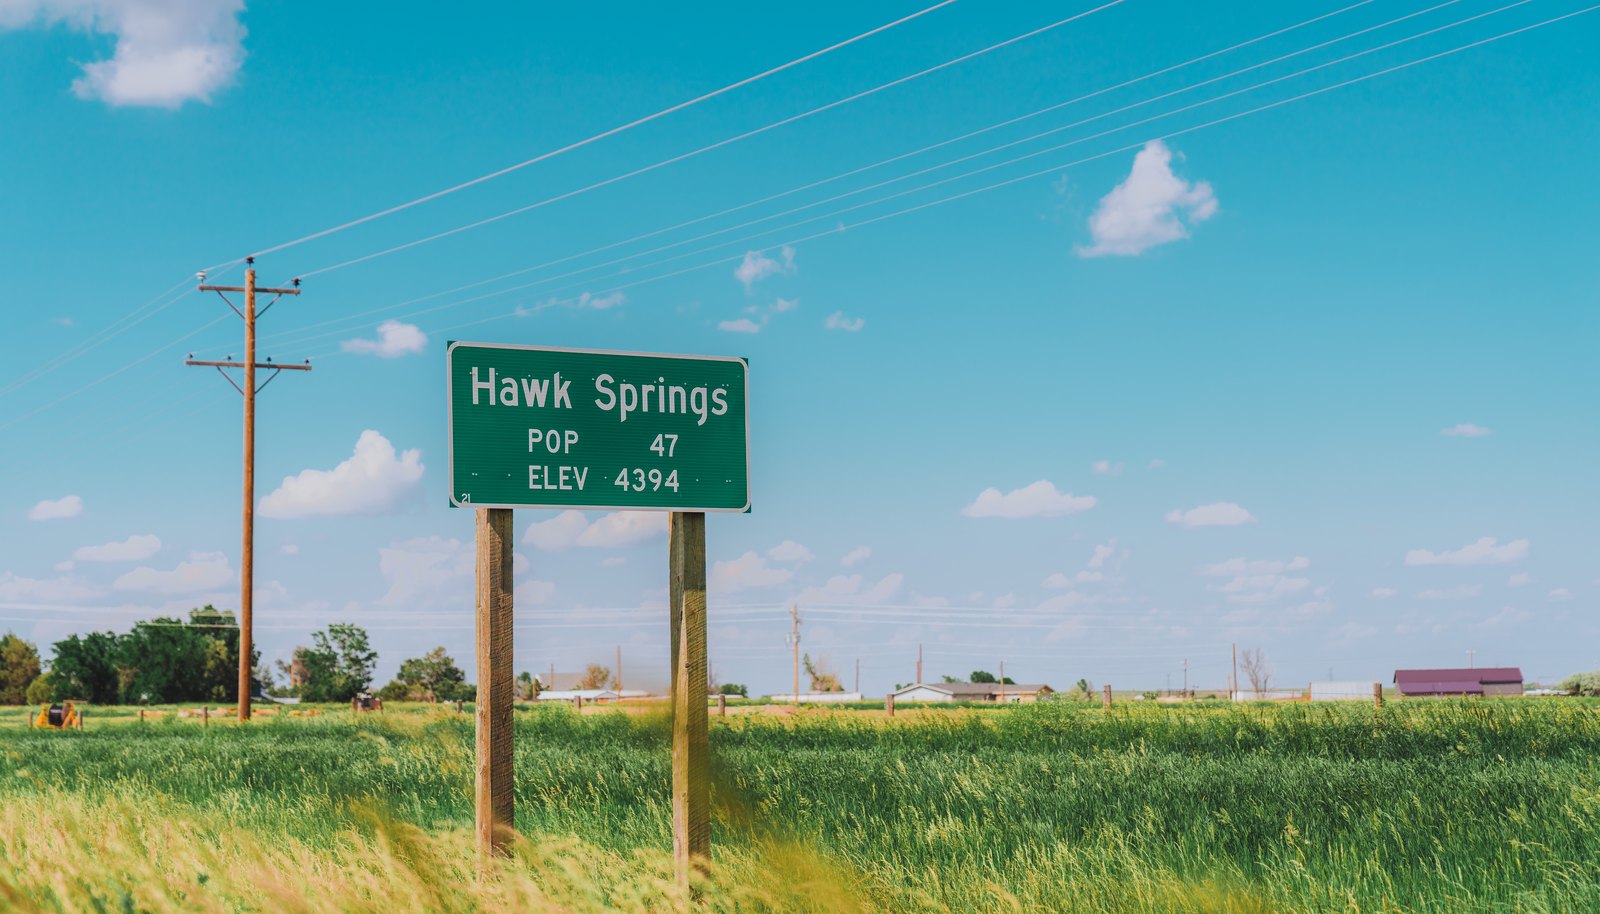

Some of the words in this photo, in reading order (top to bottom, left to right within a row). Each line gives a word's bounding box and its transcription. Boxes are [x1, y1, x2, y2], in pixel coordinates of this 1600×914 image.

[472, 366, 573, 409] Hawk
[594, 373, 728, 426] Springs
[528, 429, 579, 454] POP
[649, 433, 679, 457] 47
[528, 465, 588, 490] ELEV
[614, 468, 680, 493] 4394
[461, 493, 471, 504] 21
